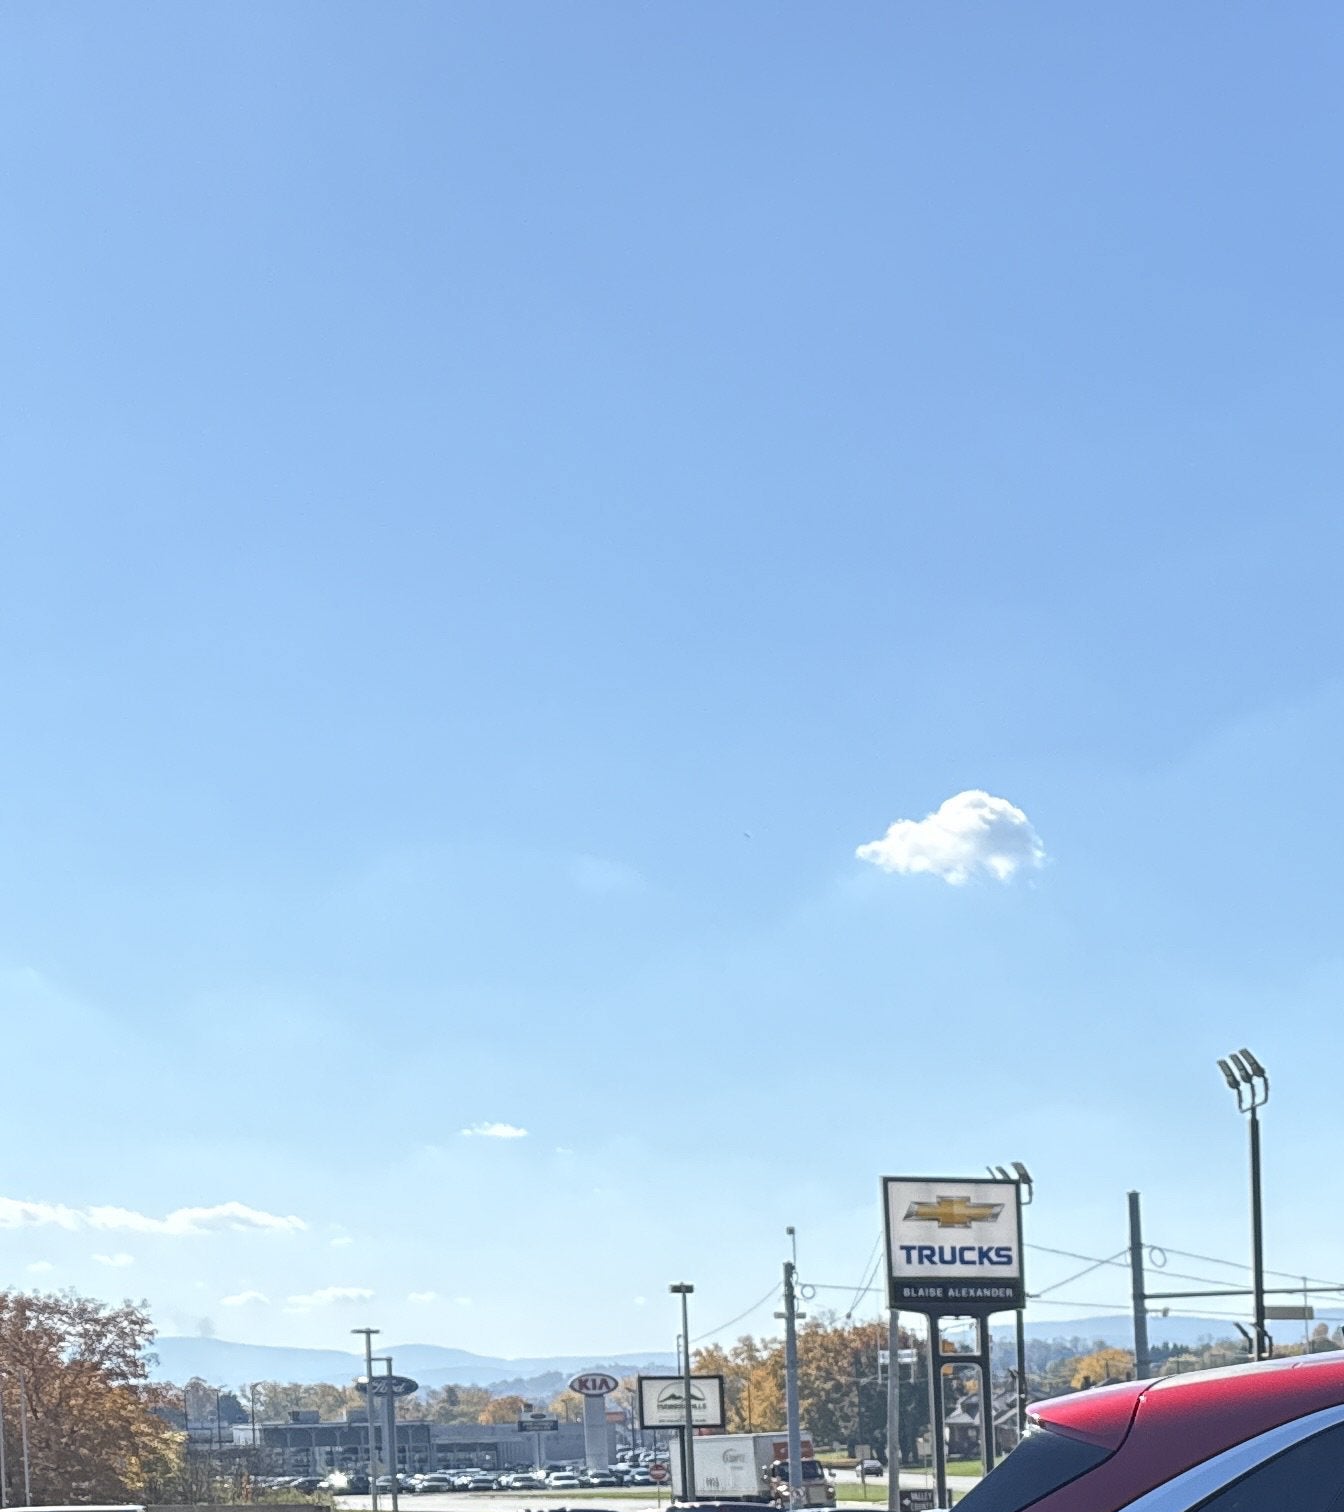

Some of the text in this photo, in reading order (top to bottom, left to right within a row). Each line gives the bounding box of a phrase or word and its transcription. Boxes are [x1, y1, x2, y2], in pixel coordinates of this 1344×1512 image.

[900, 1245, 1013, 1265] TRUCKS
[903, 1287, 1013, 1298] BLAISE ALEXANDER
[577, 1377, 611, 1390] KIA
